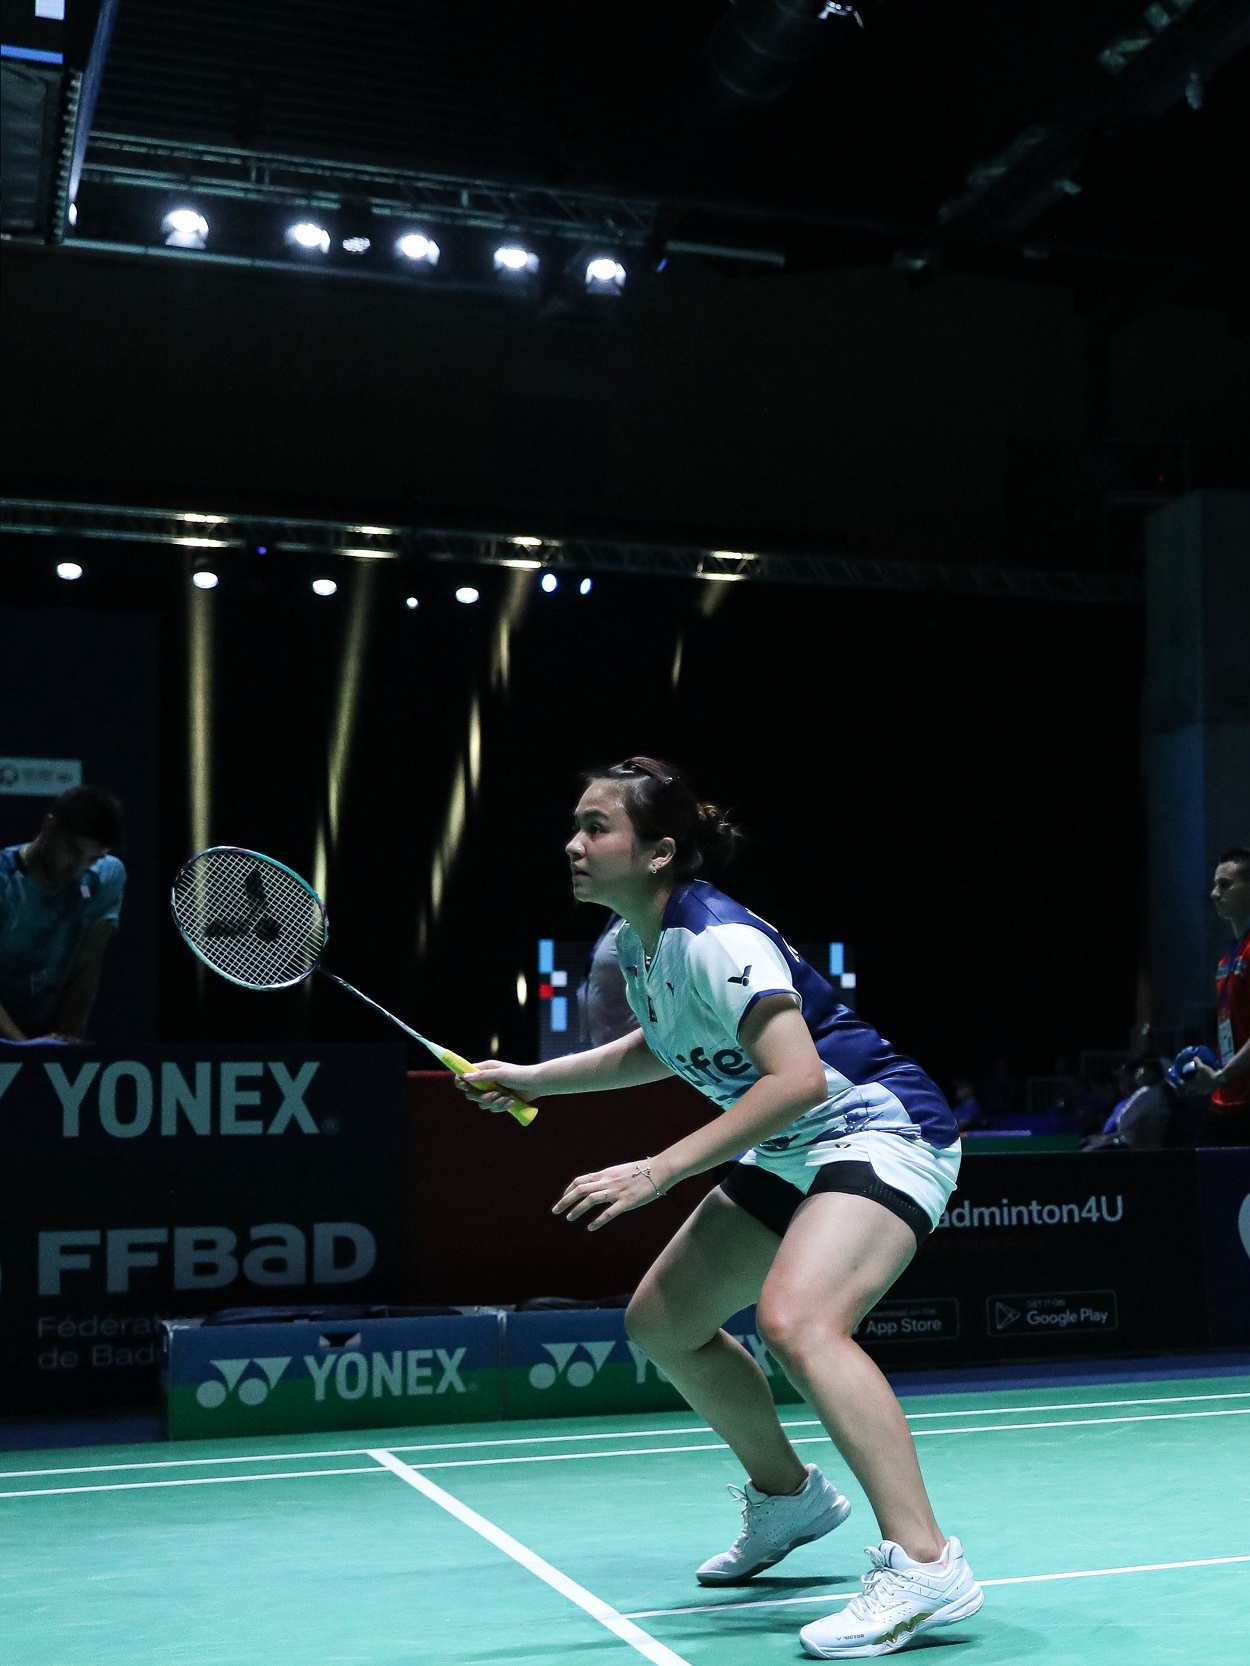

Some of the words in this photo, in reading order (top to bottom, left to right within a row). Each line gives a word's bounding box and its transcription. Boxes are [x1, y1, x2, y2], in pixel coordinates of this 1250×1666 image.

[45, 1060, 321, 1138] YONEX
[936, 1194, 1124, 1229] adminton4U
[865, 1319, 898, 1337] App
[901, 1315, 943, 1334] Store
[1026, 1309, 1078, 1327] Google
[1080, 1307, 1109, 1324] Play
[37, 1346, 79, 1370] de
[305, 1346, 468, 1402] YONEX
